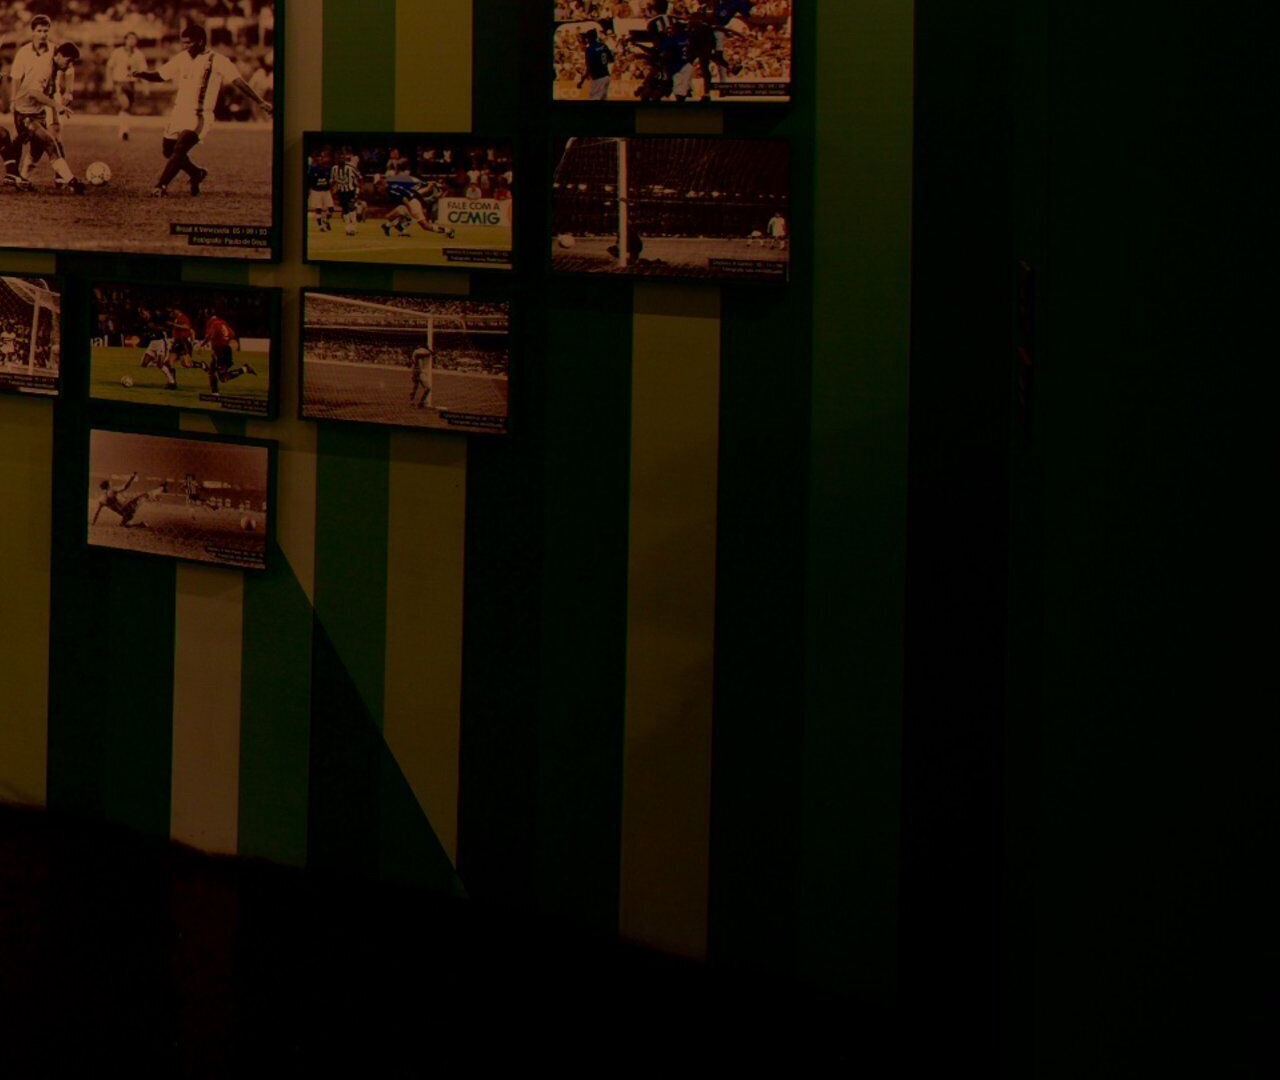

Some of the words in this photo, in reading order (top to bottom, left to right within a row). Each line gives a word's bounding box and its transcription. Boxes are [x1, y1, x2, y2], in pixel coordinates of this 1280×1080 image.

[448, 202, 467, 210] FALE
[469, 202, 491, 210] COM
[493, 202, 500, 210] A
